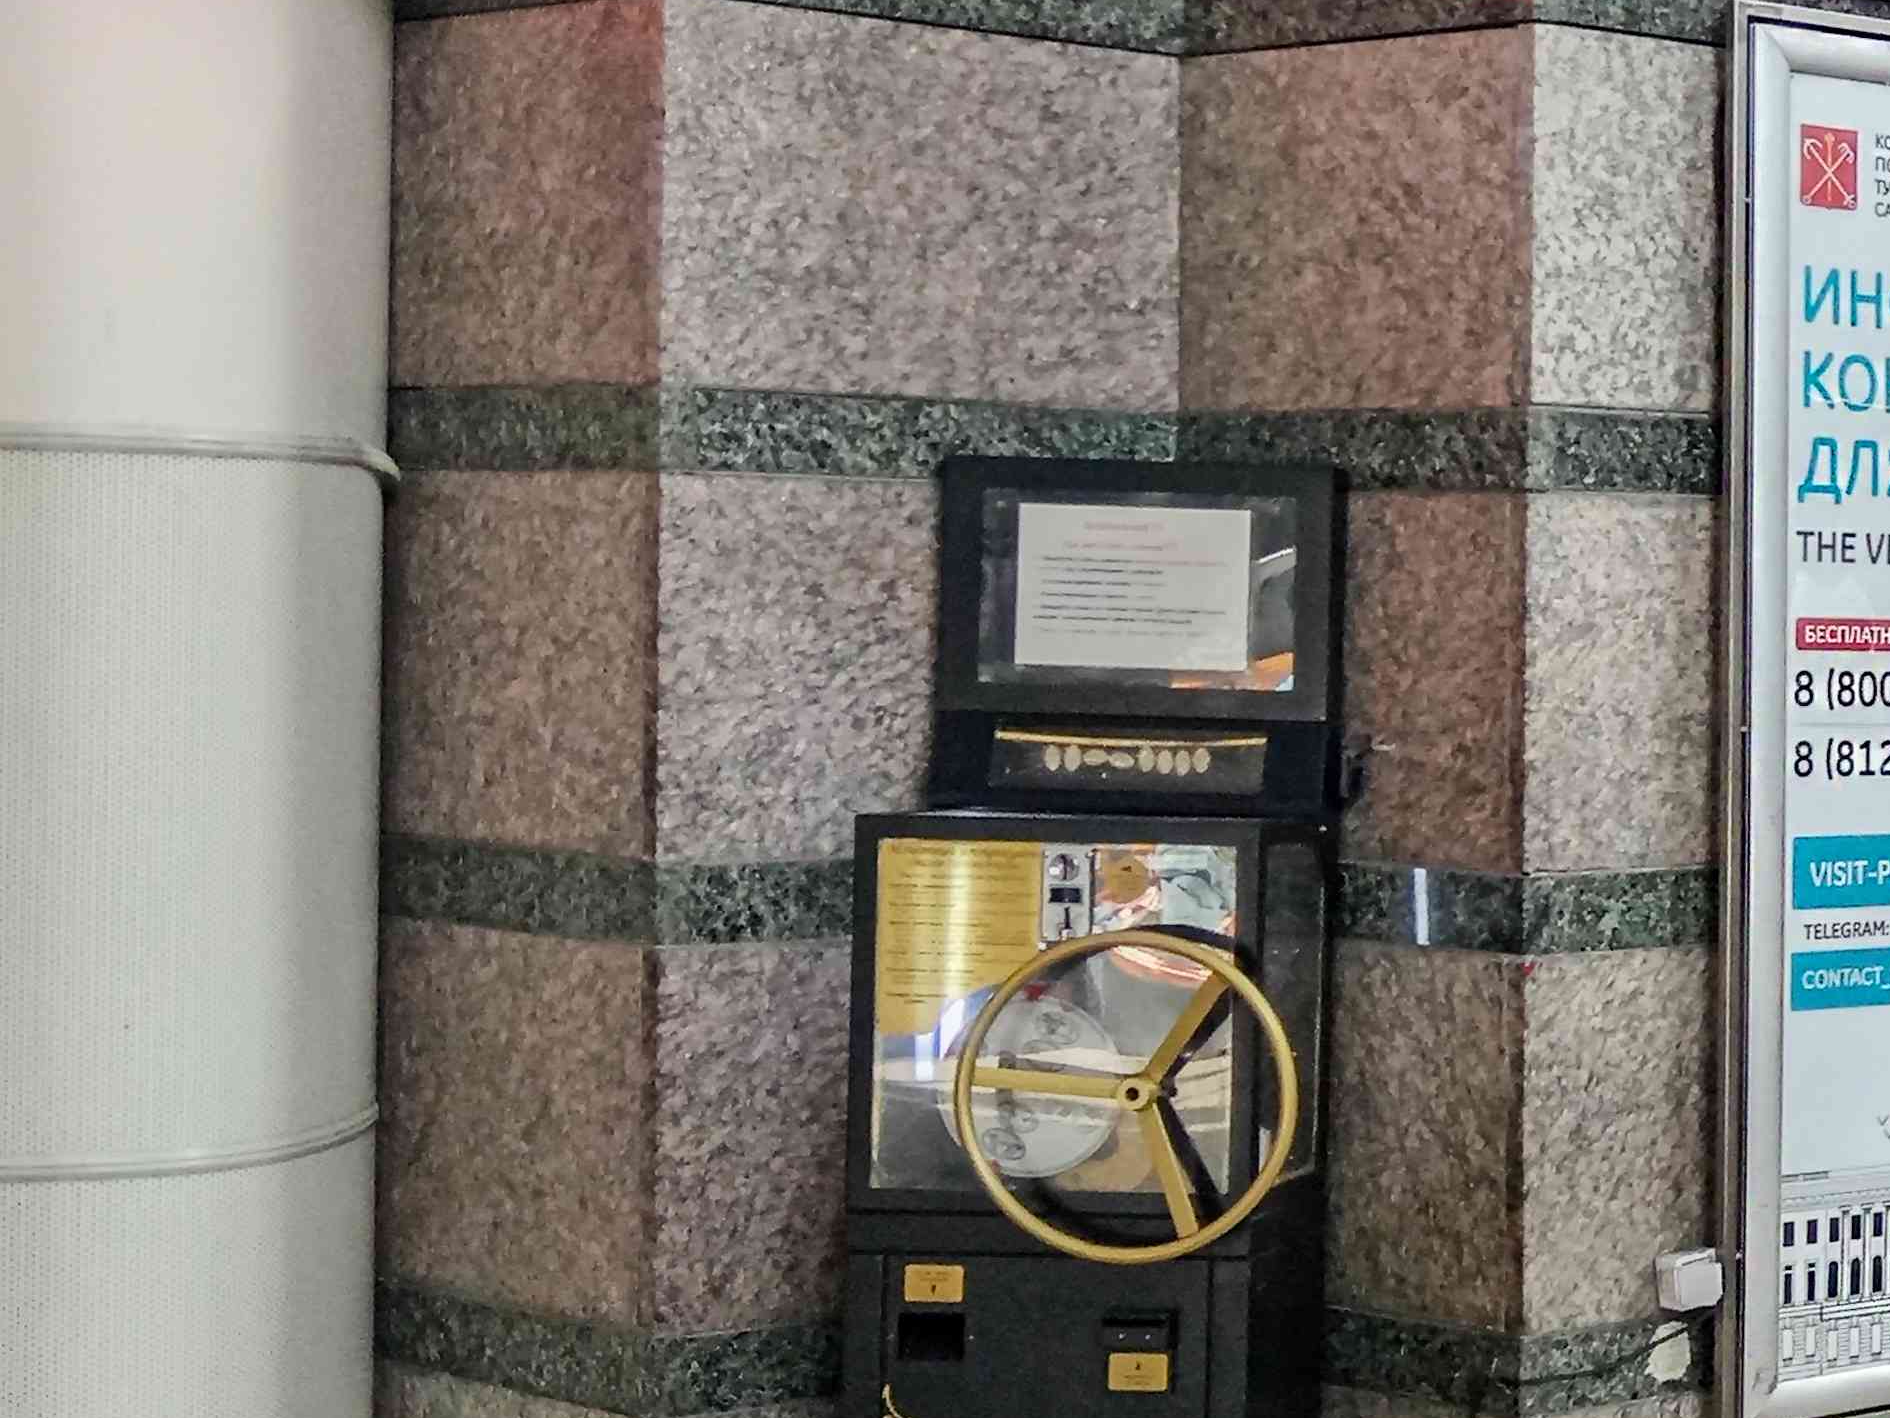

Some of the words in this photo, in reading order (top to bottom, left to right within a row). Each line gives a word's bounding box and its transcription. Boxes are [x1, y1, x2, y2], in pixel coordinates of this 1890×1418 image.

[1797, 530, 1857, 564] THE
[1794, 670, 1814, 707] 8
[1794, 740, 1814, 777] 8
[1804, 920, 1890, 941] TELEGRAM:
